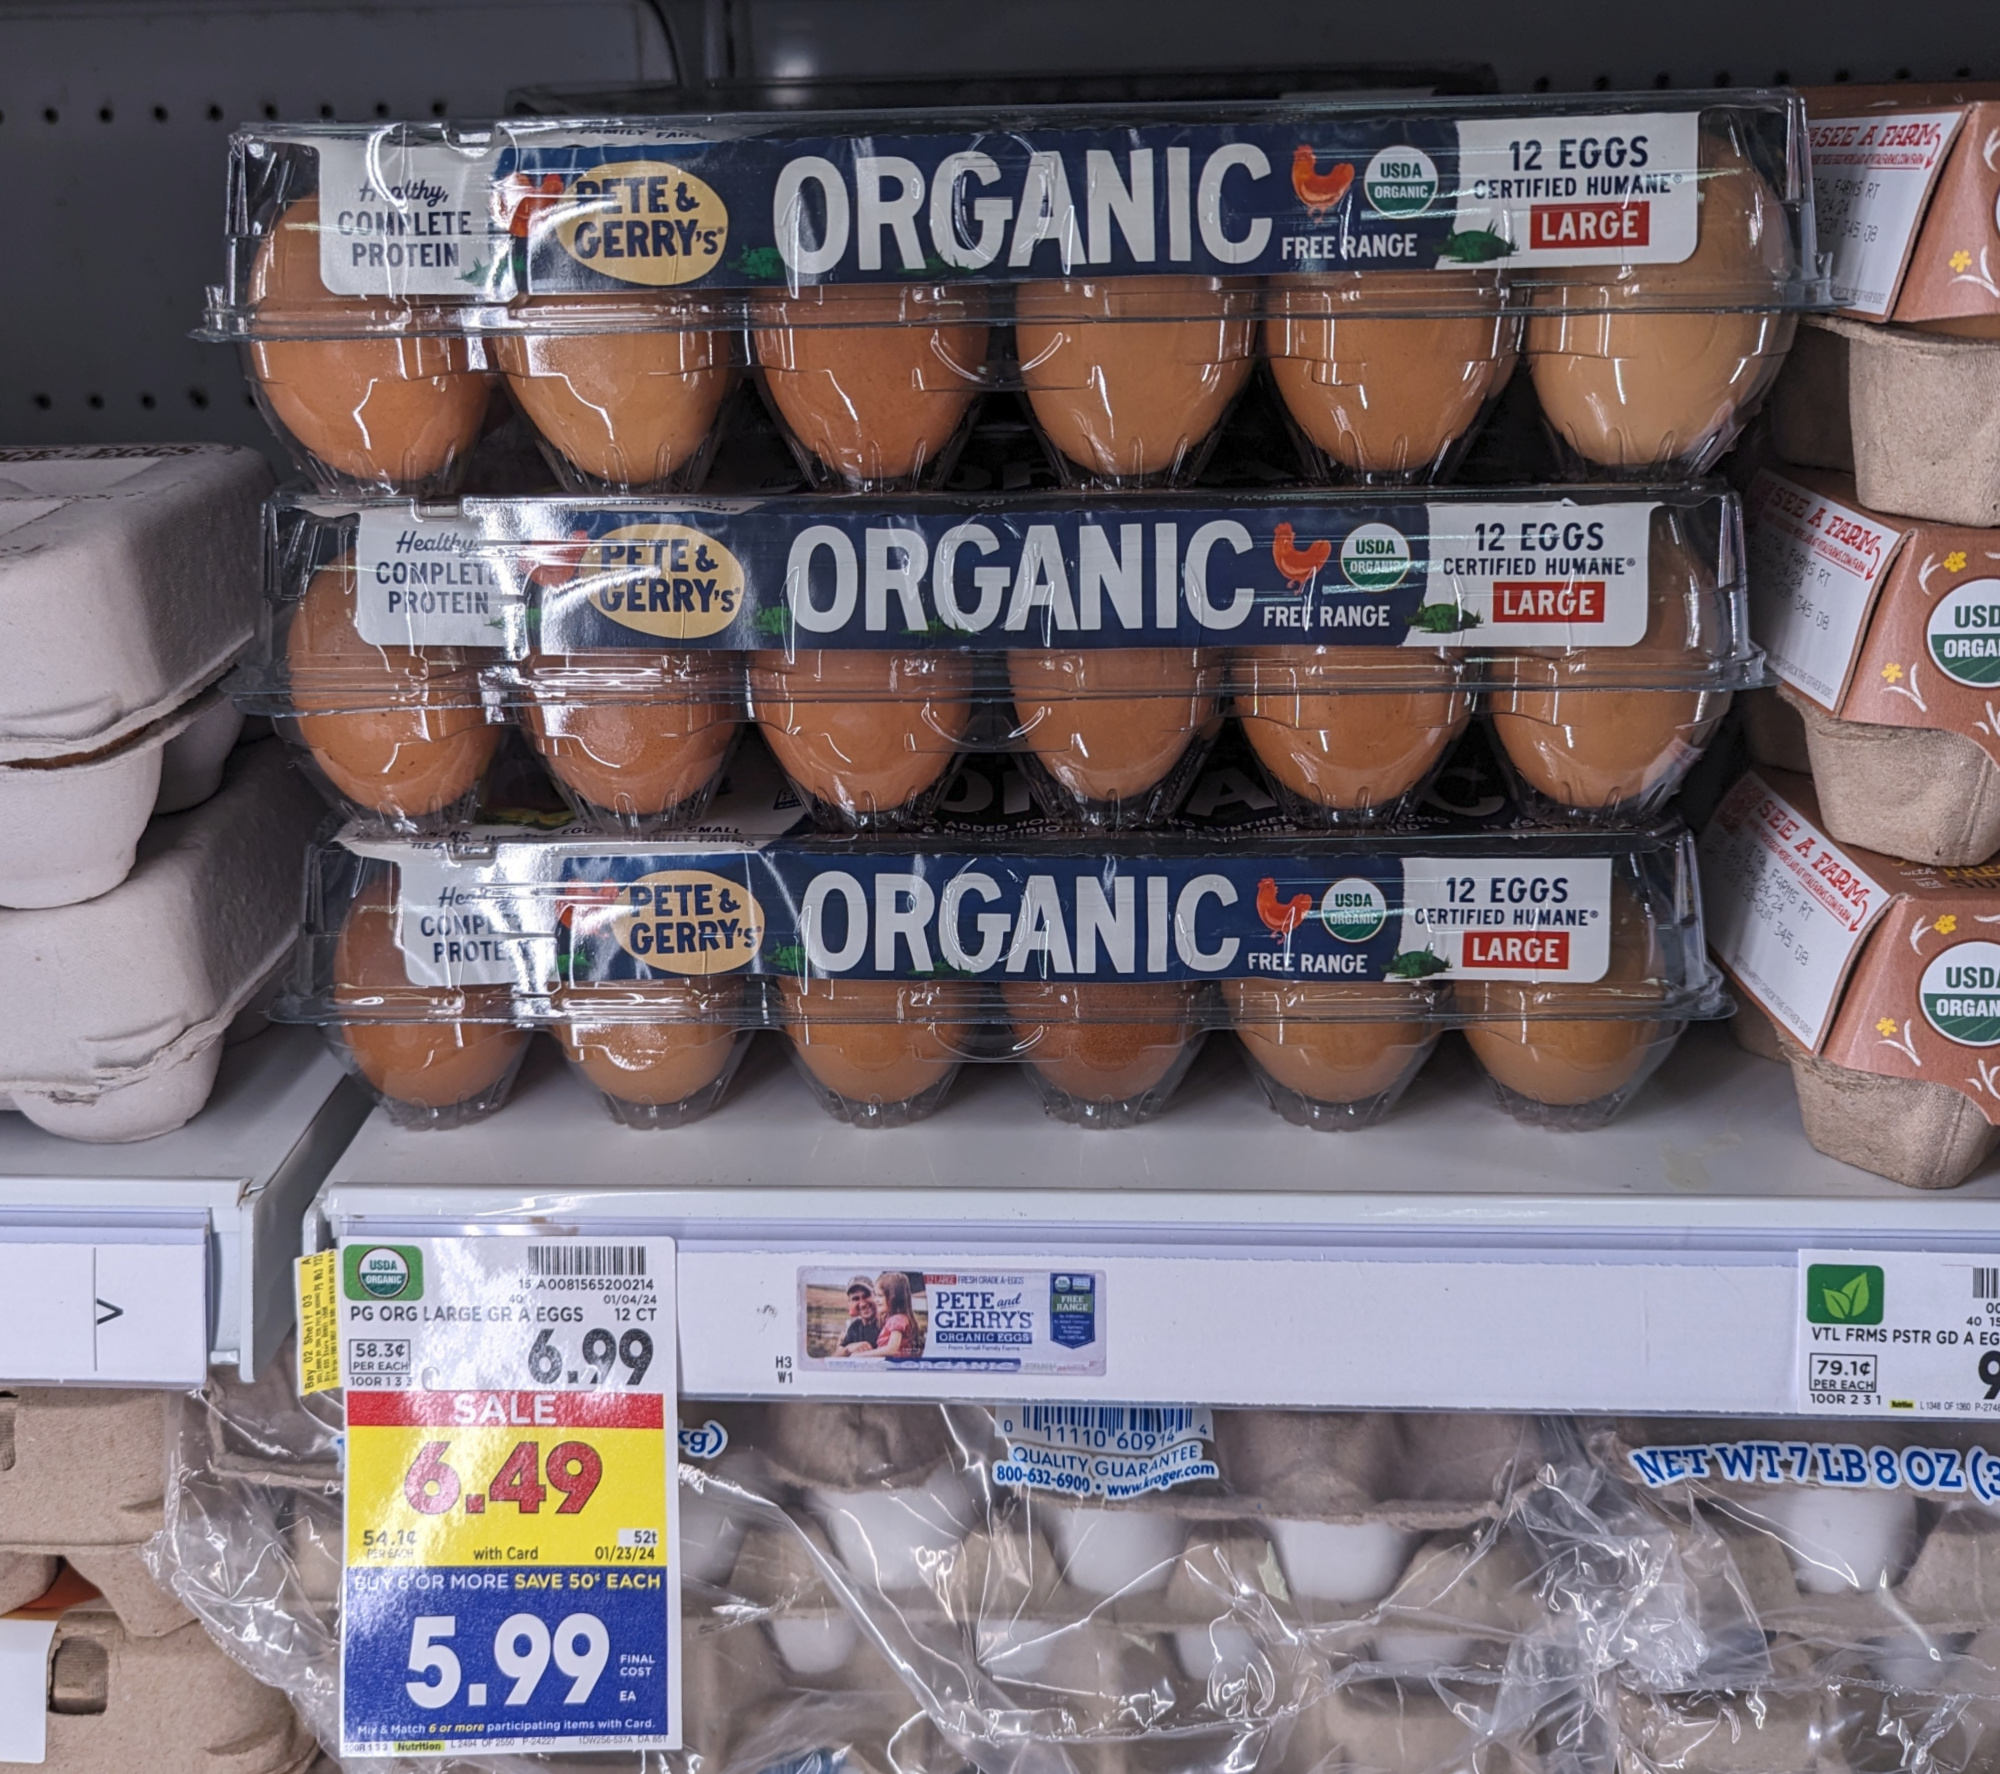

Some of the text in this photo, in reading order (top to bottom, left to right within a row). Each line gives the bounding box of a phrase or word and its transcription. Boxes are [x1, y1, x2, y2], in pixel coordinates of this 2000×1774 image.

[1817, 123, 1941, 147] SEE A FARM
[1509, 136, 1648, 171] 12 EGGS
[1380, 163, 1422, 178] USDA
[359, 179, 449, 207] Halthy,
[576, 176, 669, 214] PETE
[1374, 185, 1428, 199] ORGANIC
[1474, 179, 1576, 200] CERTIFIED
[773, 143, 1273, 274] ORGANIC
[338, 211, 472, 236] COMPLETE
[1541, 210, 1639, 241] LARGE
[352, 243, 459, 267] PROTEIN
[1282, 234, 1417, 260] FREE RANGE
[1475, 522, 1604, 552] 12 EGGS
[1807, 507, 1827, 528] A
[1824, 515, 1881, 555] FARM
[601, 538, 689, 572] PETE
[1355, 539, 1396, 555] USDA
[786, 519, 1255, 633] ORGANIC
[1349, 561, 1402, 574] ORGANIC
[1443, 557, 1537, 576] CERTIFIED
[388, 591, 489, 614] PROTEIN
[1503, 589, 1595, 616] LARGE
[1263, 605, 1390, 627] FREE RANGE
[1944, 639, 2000, 658] ORGA
[1757, 799, 1800, 842] SEE
[1794, 837, 1816, 859] A
[1811, 852, 1869, 907] FARM
[1446, 877, 1568, 904] 12 EGGS
[630, 884, 713, 918] PETE
[1335, 893, 1372, 908] USDA
[801, 870, 1241, 974] ORGANIC
[1329, 912, 1378, 925] ORGANIC
[1414, 908, 1504, 926] CERTIFIED
[1472, 938, 1560, 964] LARGE
[1248, 953, 1367, 973] FREE RANGE
[369, 1260, 398, 1271] USDA
[366, 1274, 402, 1285] ORGANIC
[603, 1294, 657, 1306] 01/04/24
[936, 1291, 1022, 1309] PETE and
[1057, 1303, 1088, 1311] RANGE
[1061, 1295, 1084, 1303] FREE
[350, 1305, 657, 1322] PG ORG LARGE GR A EGGS 12 CT
[935, 1310, 1032, 1329] GERRY'S
[1966, 1316, 1982, 1327] 40
[303, 1294, 316, 1389] Bay 02 Shelf 03
[939, 1332, 1030, 1342] ORGANIC EGGS
[1812, 1327, 1840, 1341] VTL
[1846, 1328, 1887, 1342] FRMS
[1893, 1330, 1931, 1344] PSTR
[1936, 1330, 1958, 1345] GD
[1963, 1331, 1974, 1345] A
[353, 1361, 409, 1371] PER EACH
[356, 1343, 405, 1358] 58.3¢
[528, 1328, 654, 1385] 6.99
[775, 1356, 792, 1368] H3
[1817, 1359, 1871, 1376] 79.1¢
[778, 1371, 793, 1384] W1
[1813, 1379, 1874, 1391] PER EACH
[454, 1395, 557, 1424] SALE
[1851, 1395, 1859, 1405] 2
[1863, 1395, 1871, 1405] 3
[1004, 1419, 1013, 1432] 0
[1044, 1426, 1106, 1448] 11110
[1199, 1423, 1208, 1436] 4
[1013, 1444, 1198, 1478] QUALITY GUARANTEE
[1633, 1449, 1708, 1485] NET
[1716, 1445, 1781, 1481] WT
[1788, 1447, 1809, 1477] 7
[1818, 1448, 1867, 1483] LB
[1874, 1451, 1897, 1485] 8
[1906, 1450, 1962, 1487] OZ
[404, 1440, 603, 1515] 6.49
[997, 1464, 1215, 1497] 800-632-6900 www.kroger.com
[363, 1529, 418, 1547] 54.1¢
[473, 1546, 656, 1561] with Card 01/23/24
[354, 1574, 393, 1591] BUY
[415, 1573, 444, 1590] OR
[451, 1573, 509, 1589] MORE
[514, 1573, 562, 1590] SAVE
[606, 1573, 661, 1589] EACH
[405, 1612, 610, 1710] 5.99
[620, 1654, 655, 1665] FINAL
[620, 1666, 652, 1677] COST
[620, 1691, 636, 1702] EA
[357, 1724, 378, 1736] Mix
[390, 1722, 426, 1735] Match
[439, 1724, 452, 1733] or
[455, 1723, 485, 1732] more
[487, 1719, 561, 1734] participating
[563, 1718, 595, 1730] items
[597, 1718, 622, 1729] with
[625, 1717, 656, 1729] Card.
[397, 1741, 442, 1752] Nutrition
[481, 1739, 494, 1748] OF
